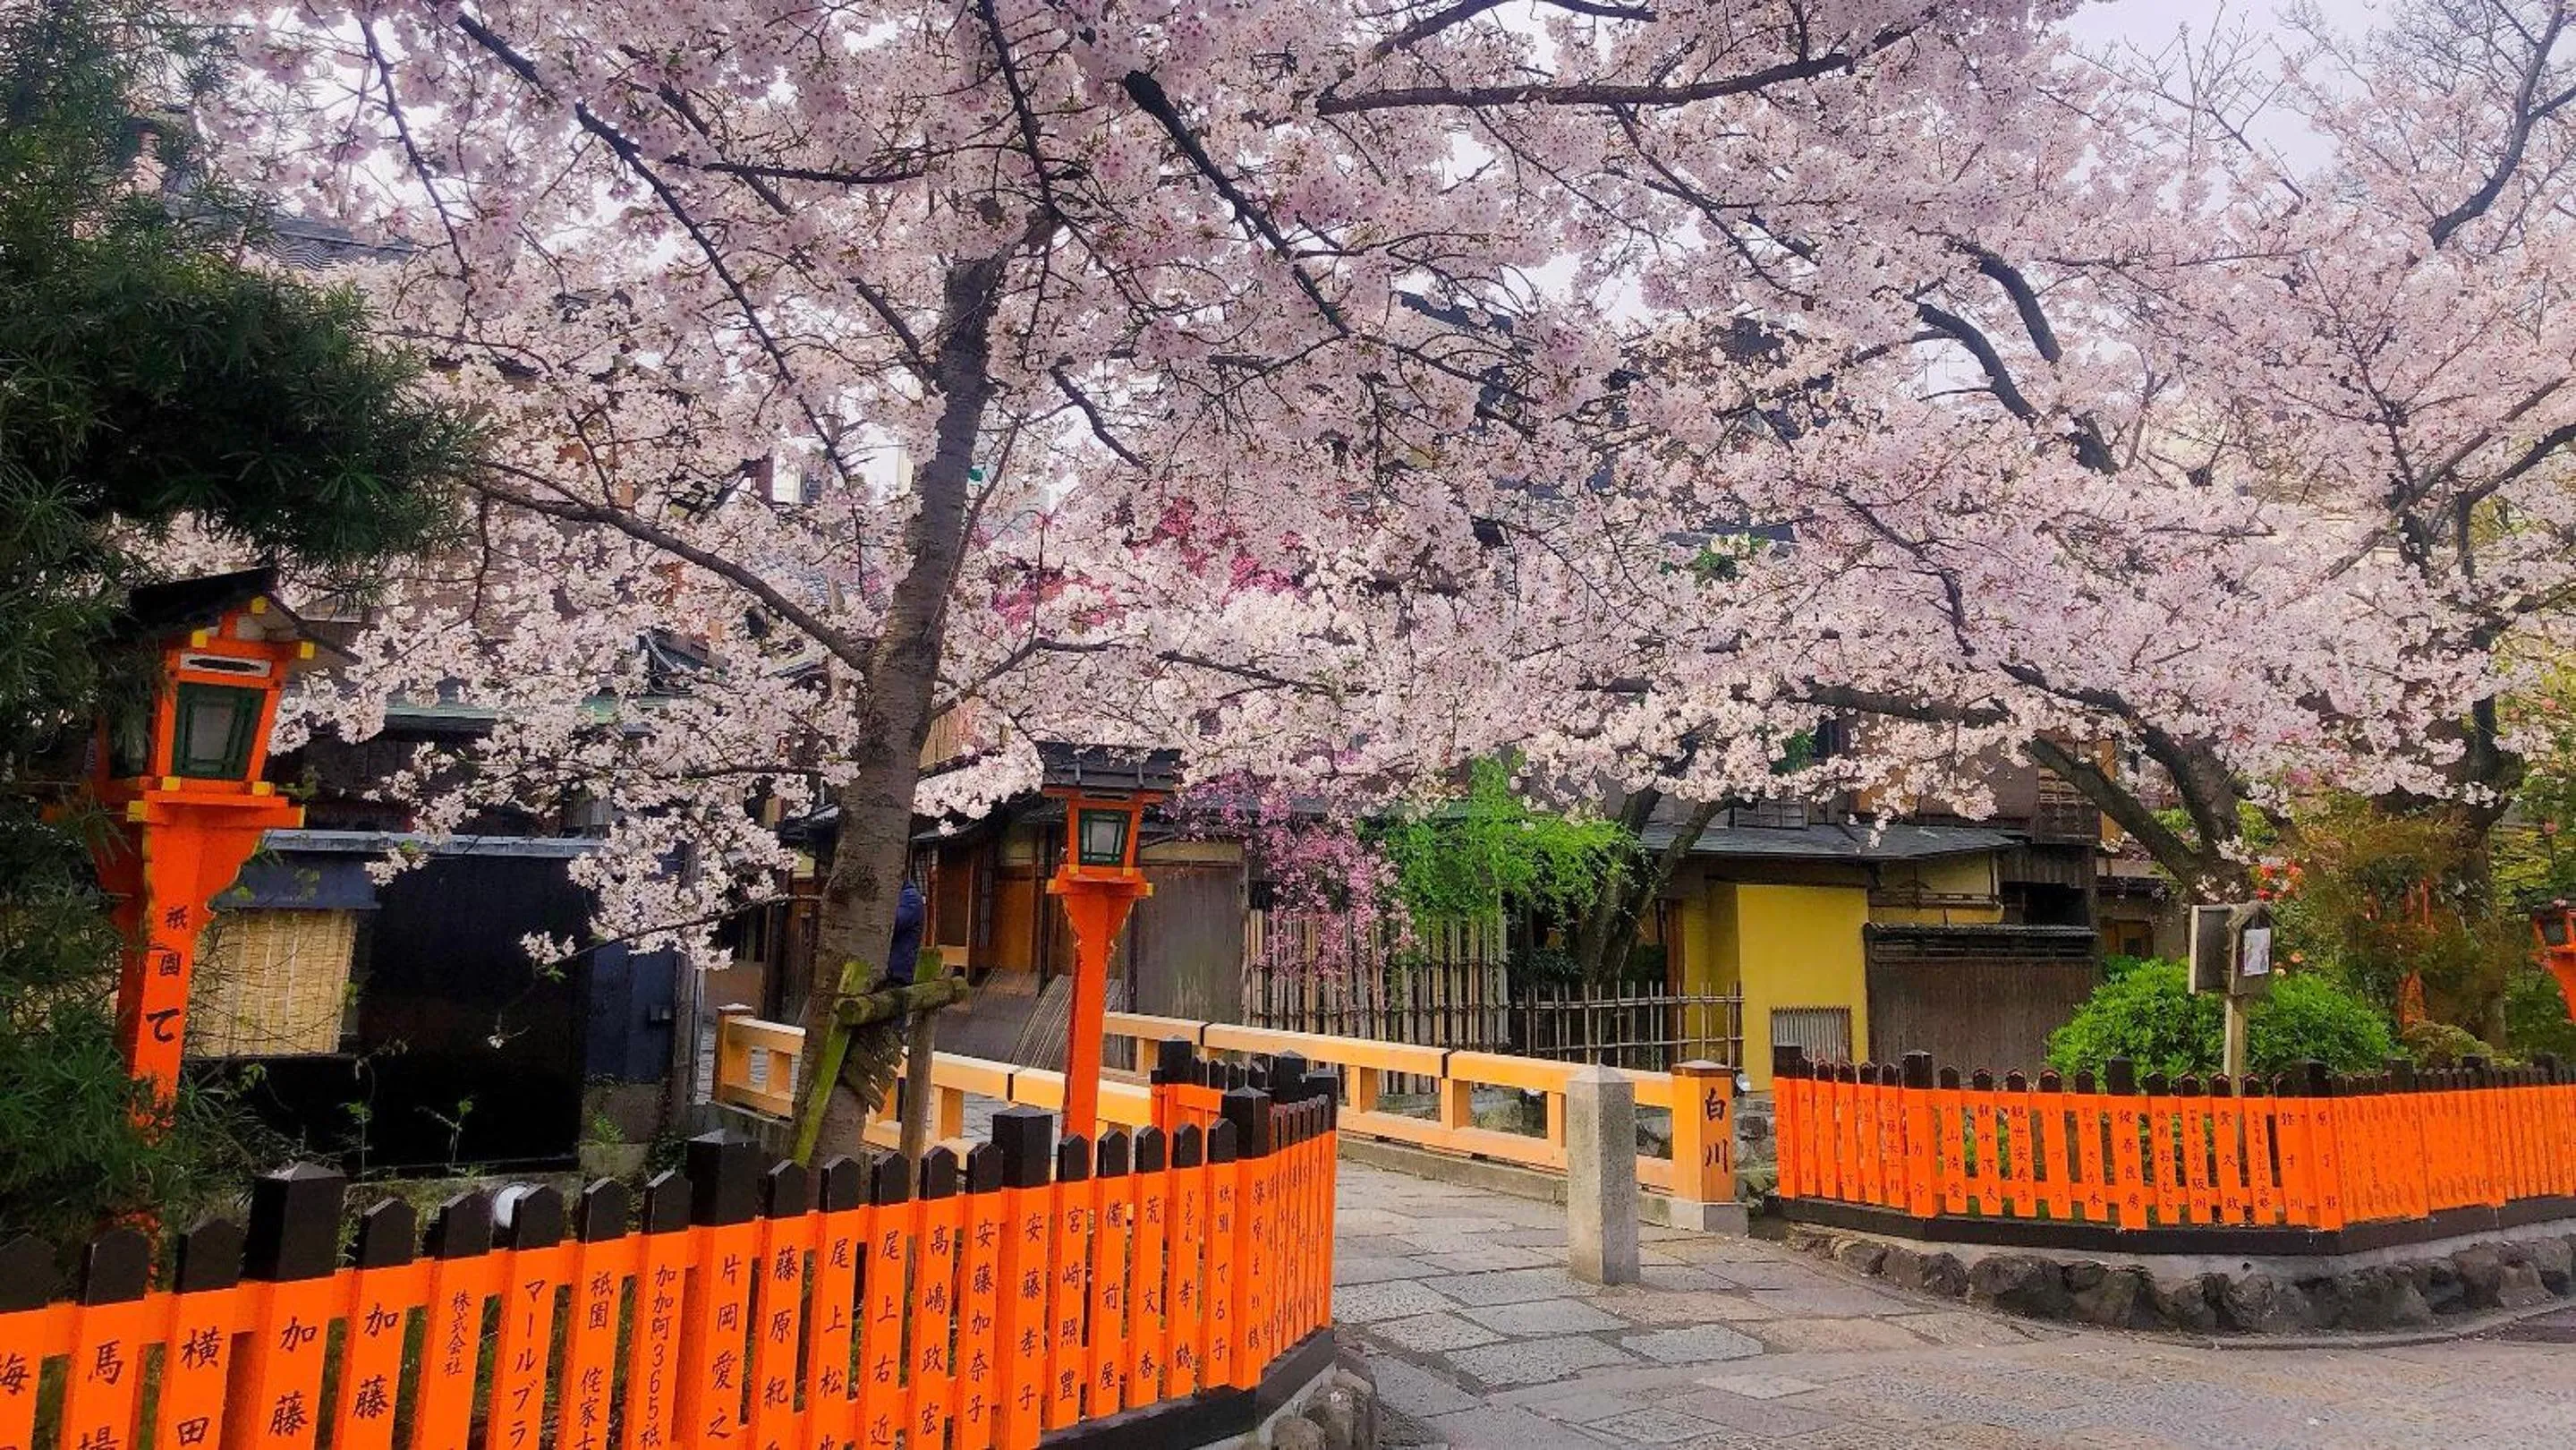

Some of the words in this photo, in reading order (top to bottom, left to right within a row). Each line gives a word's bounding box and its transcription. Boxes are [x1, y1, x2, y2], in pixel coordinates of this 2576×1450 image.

[1705, 1087, 1729, 1175] 白川
[176, 1325, 224, 1447] 横田
[268, 1315, 318, 1436] 加藤
[353, 1301, 400, 1420] 加藤
[444, 1289, 472, 1377] 株式会社
[508, 1278, 546, 1450] マールブラ
[707, 1254, 742, 1440] 片岡愛之
[764, 1244, 799, 1450] 藤原紀
[870, 1229, 901, 1446] 尾上右近
[967, 1217, 996, 1424] 安藤加奈子
[1018, 1212, 1044, 1412] 安藤孝子
